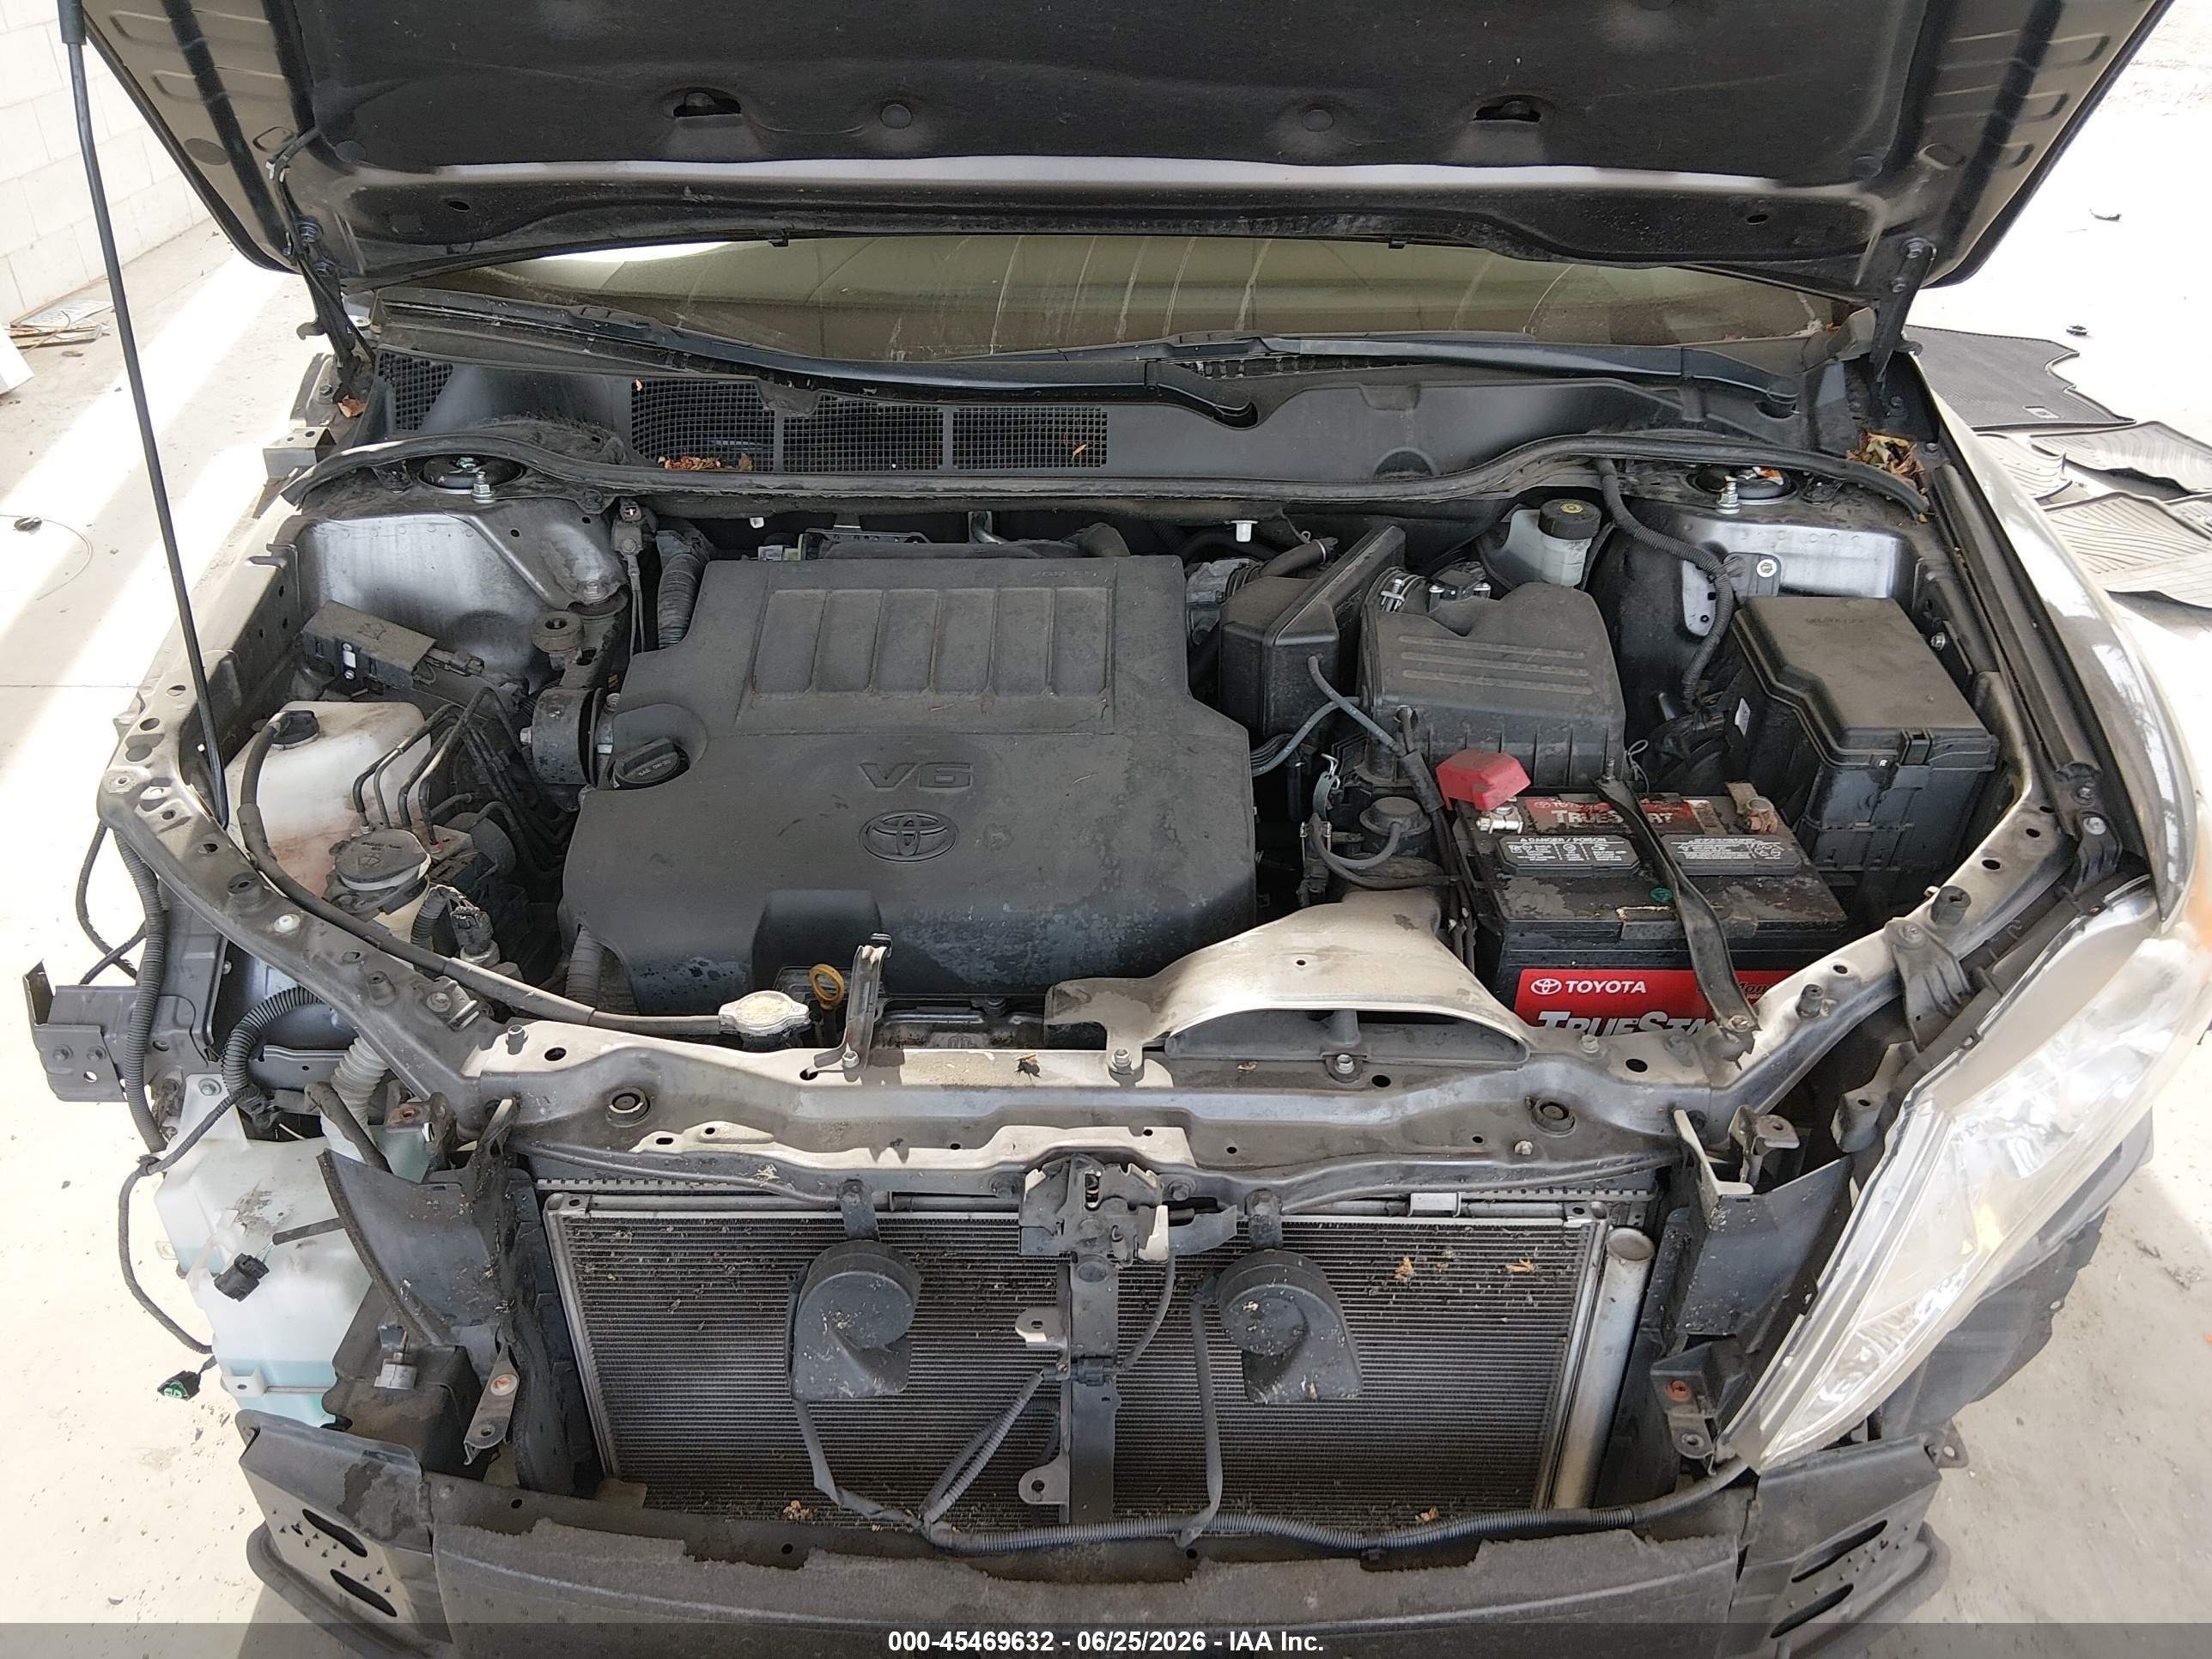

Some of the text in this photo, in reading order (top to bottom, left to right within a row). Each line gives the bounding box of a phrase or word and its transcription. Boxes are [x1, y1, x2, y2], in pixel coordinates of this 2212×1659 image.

[859, 762, 972, 793] V6
[1564, 980, 1647, 994] TOYOTA
[1538, 1011, 1717, 1036] TRUESTA
